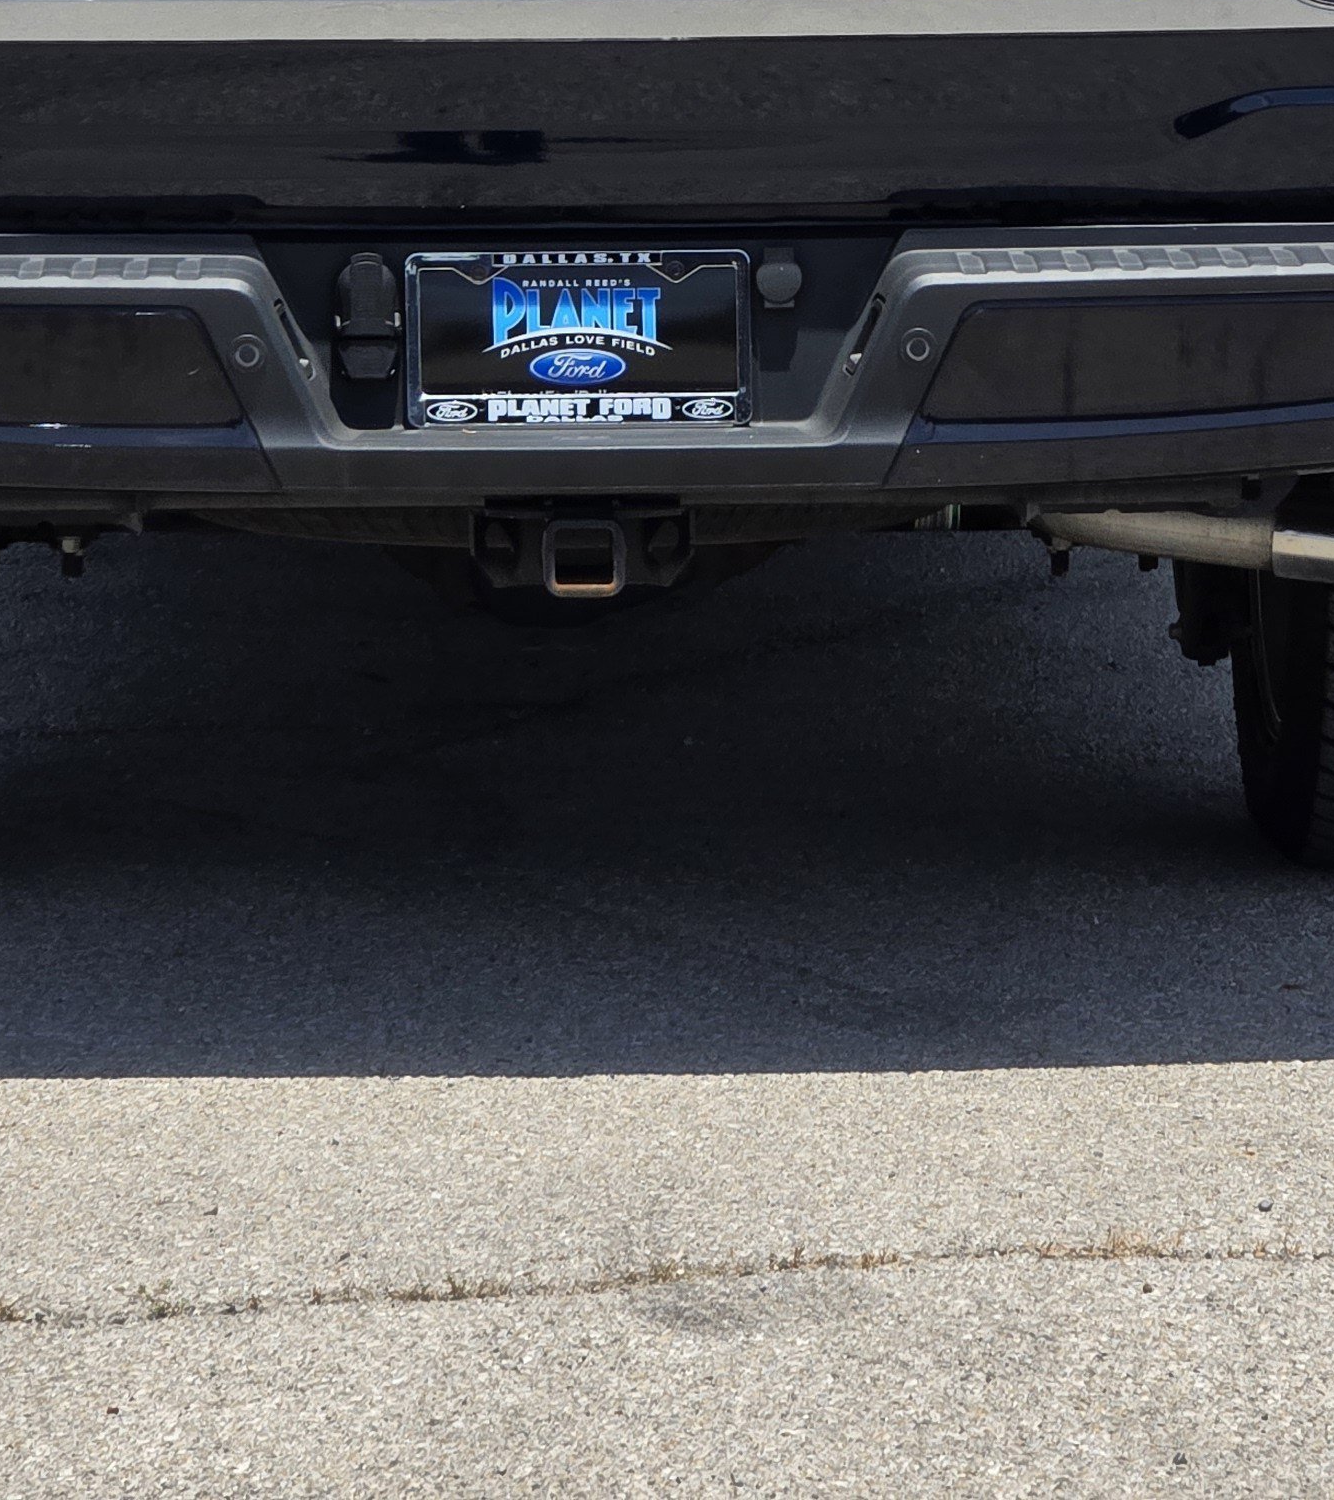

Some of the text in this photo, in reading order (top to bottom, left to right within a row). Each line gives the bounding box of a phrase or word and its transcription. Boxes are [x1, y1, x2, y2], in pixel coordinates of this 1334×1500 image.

[619, 252, 652, 263] TX
[522, 278, 632, 288] RANDALL REED'S
[493, 277, 662, 347] PLANET
[500, 334, 657, 360] DALLAS LOVE FIELD
[546, 352, 609, 380] Ford
[488, 397, 672, 422] PLANET FORD
[691, 400, 725, 416] Ford
